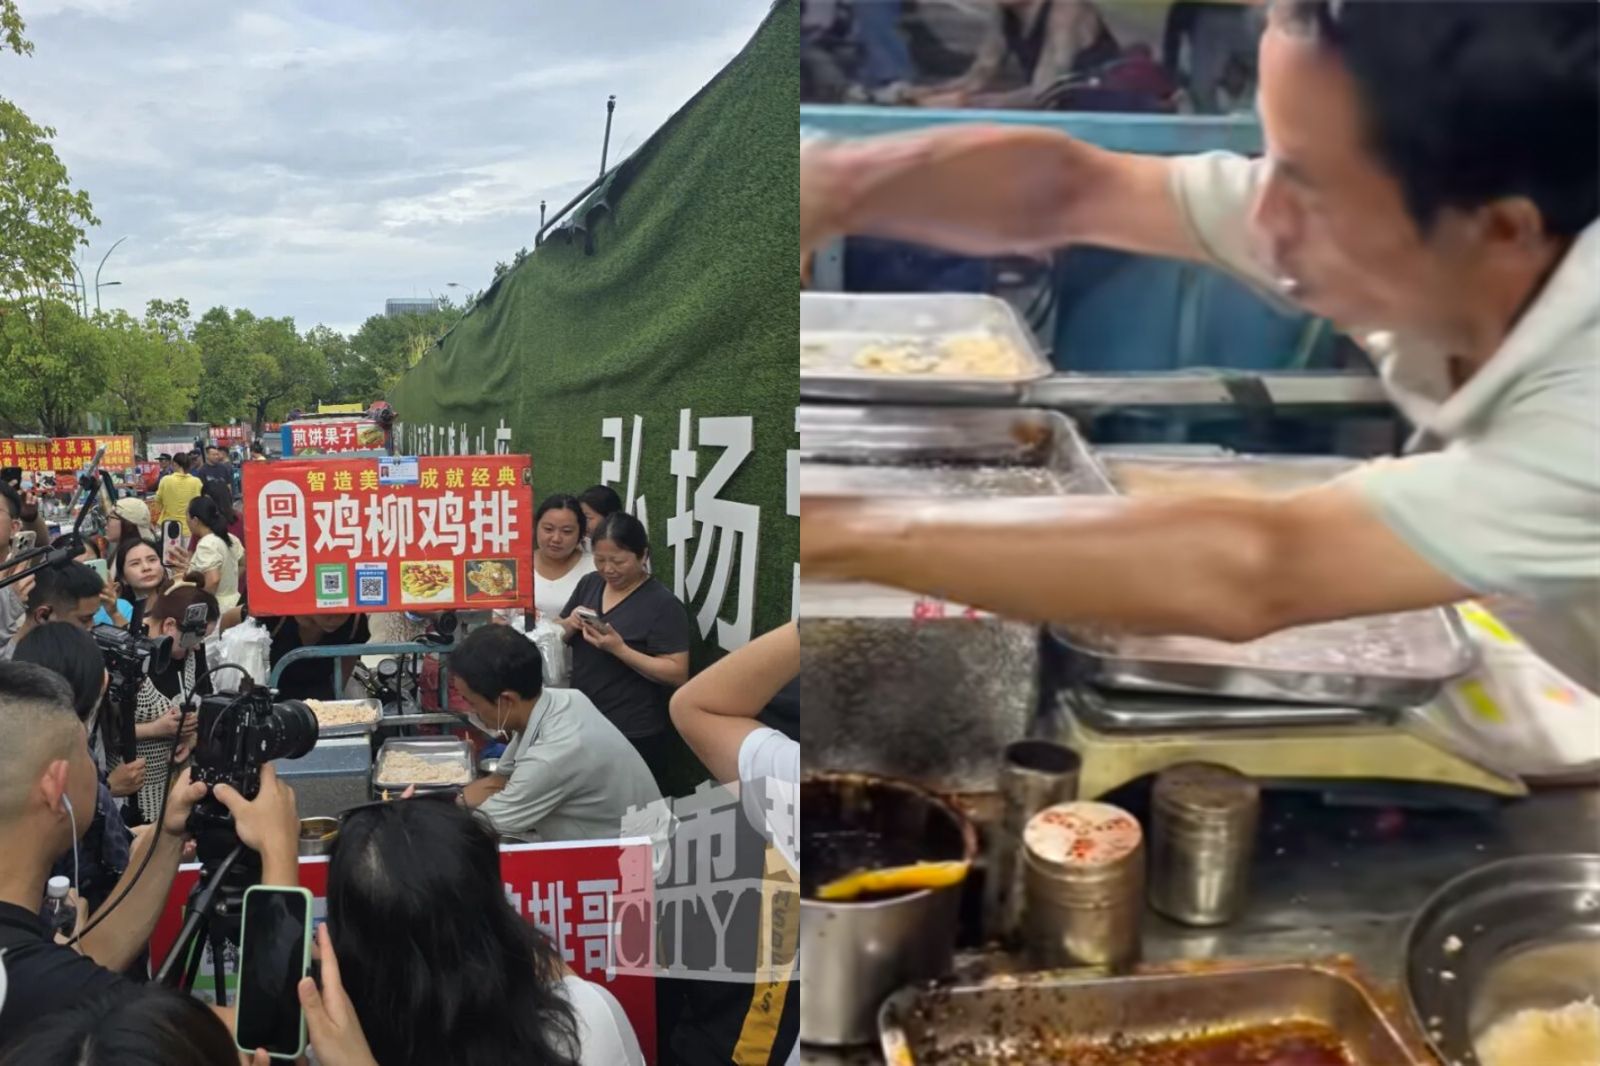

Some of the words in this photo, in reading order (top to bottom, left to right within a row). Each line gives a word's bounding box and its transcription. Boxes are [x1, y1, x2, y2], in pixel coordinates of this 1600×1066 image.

[292, 427, 355, 447] 煎饼果子
[307, 470, 404, 492] 智造美
[420, 466, 516, 489] 成就经典
[265, 494, 302, 582] 回头客
[312, 490, 519, 558] 鸡柳鸡排
[601, 408, 799, 652] 弘扬
